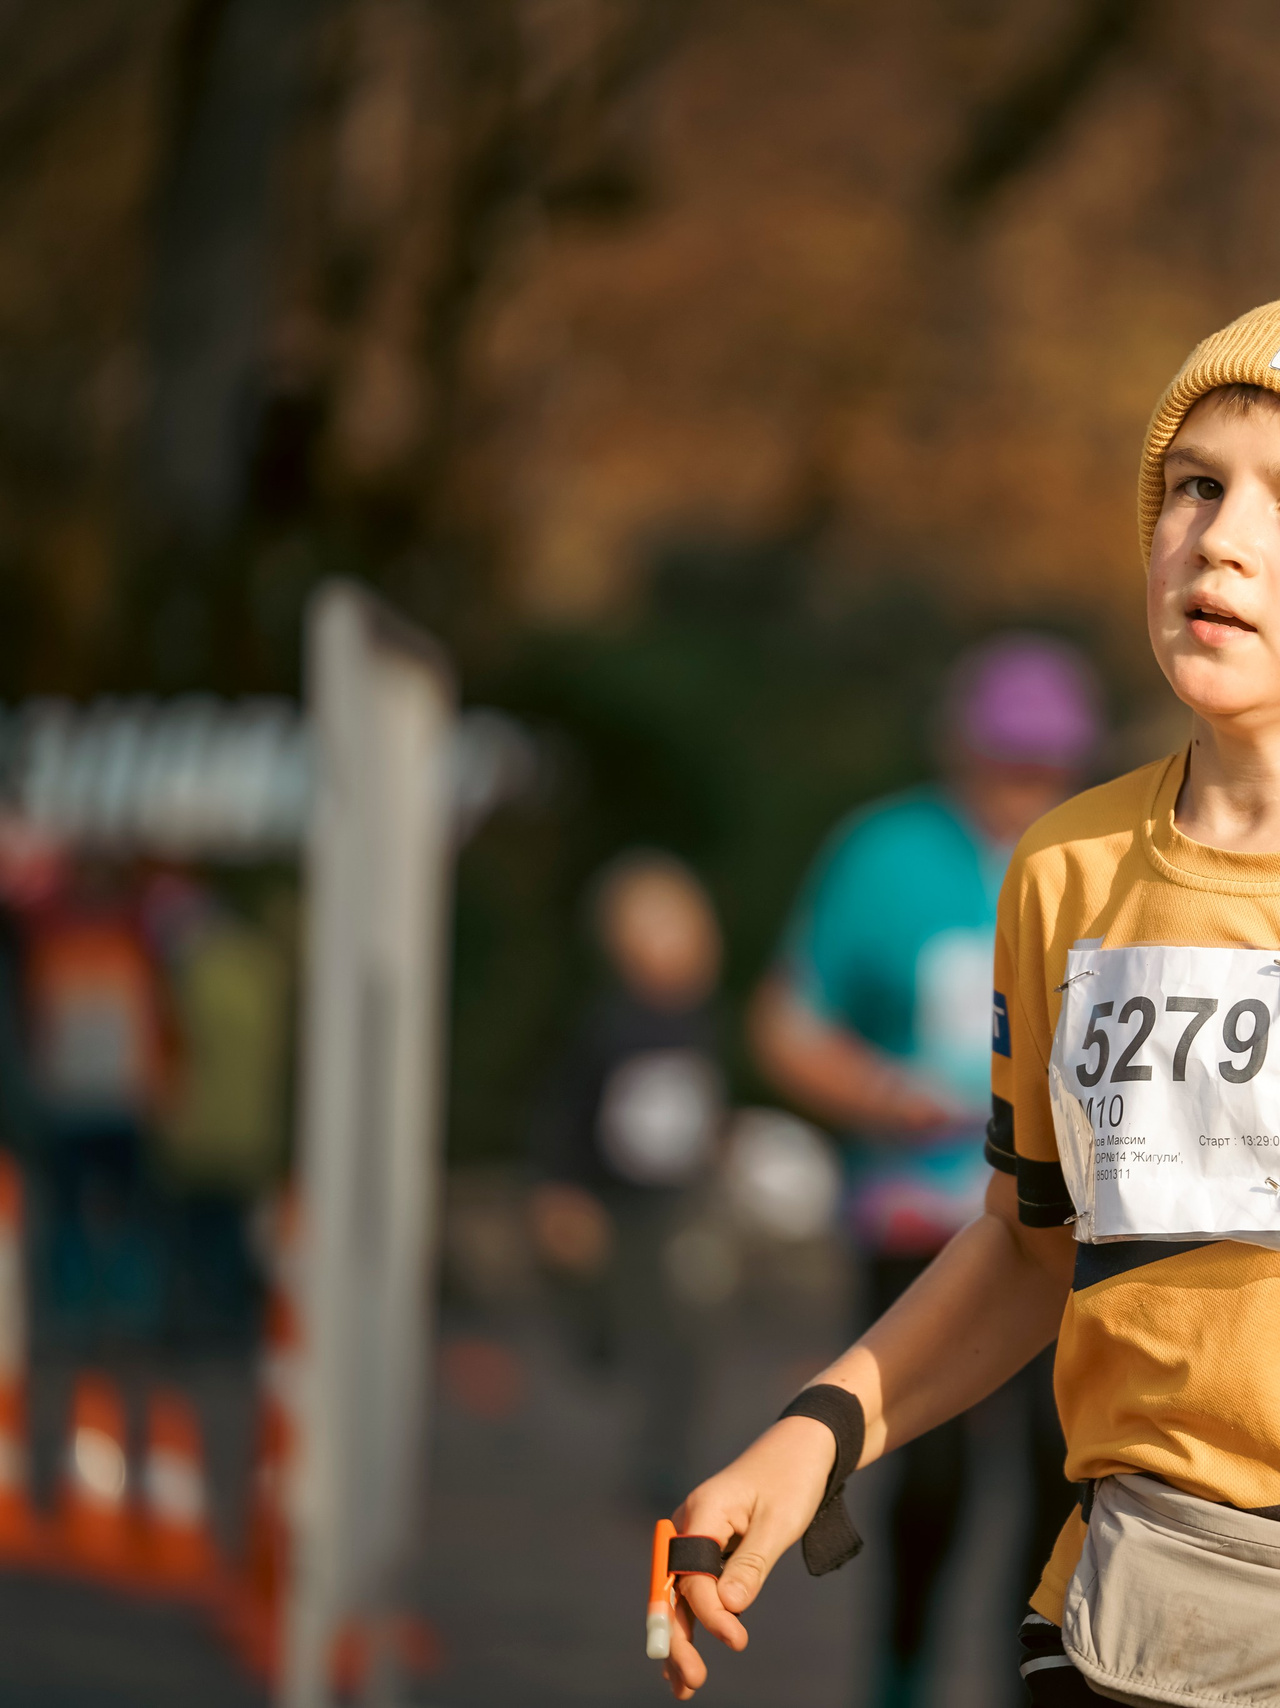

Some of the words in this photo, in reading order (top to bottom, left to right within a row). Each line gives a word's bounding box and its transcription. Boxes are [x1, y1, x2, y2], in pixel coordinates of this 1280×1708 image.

[1076, 996, 1271, 1088] 5279
[1107, 1135, 1146, 1146] Максим
[1199, 1135, 1230, 1148] Старт
